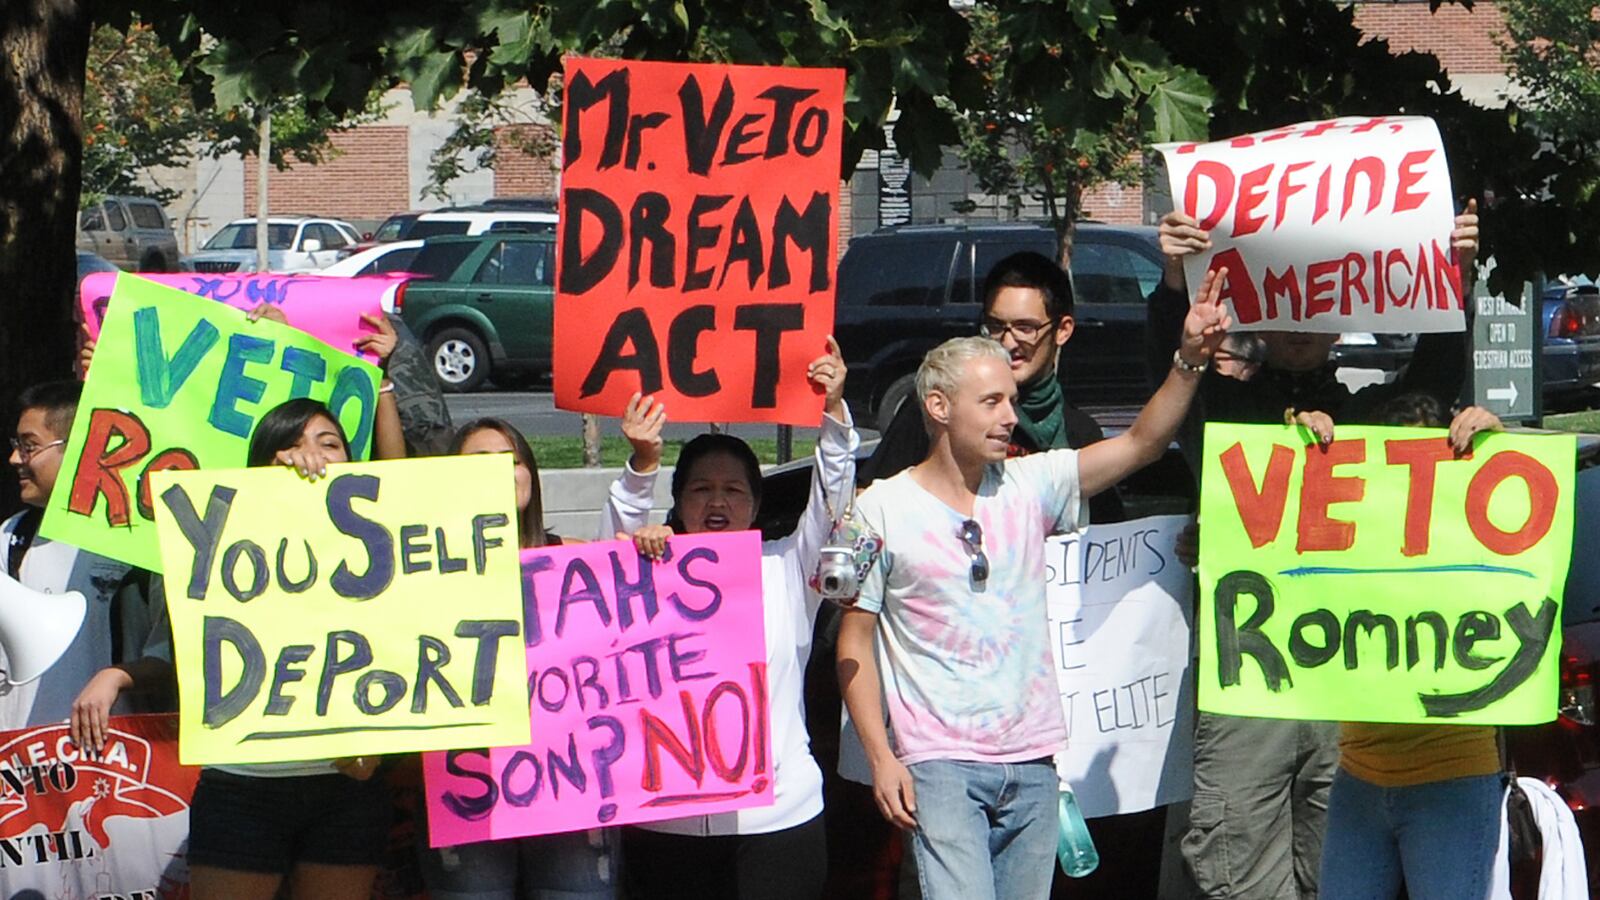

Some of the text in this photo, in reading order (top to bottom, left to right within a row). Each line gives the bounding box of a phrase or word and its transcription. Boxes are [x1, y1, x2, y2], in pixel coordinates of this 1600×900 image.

[563, 67, 672, 172] Mr.
[678, 73, 830, 177] VETO
[559, 187, 832, 295] DREAM
[1184, 149, 1436, 238] DEFINE
[1207, 239, 1465, 324] AMERICAN
[133, 306, 375, 461] VETO
[579, 303, 805, 409] ACT
[161, 473, 509, 602] YOU SELF
[1220, 437, 1559, 557] VETO
[202, 616, 521, 729] DEPORT
[1214, 570, 1558, 718] Romney
[442, 661, 768, 823] SON? NO!
[1093, 672, 1176, 733] ELITE
